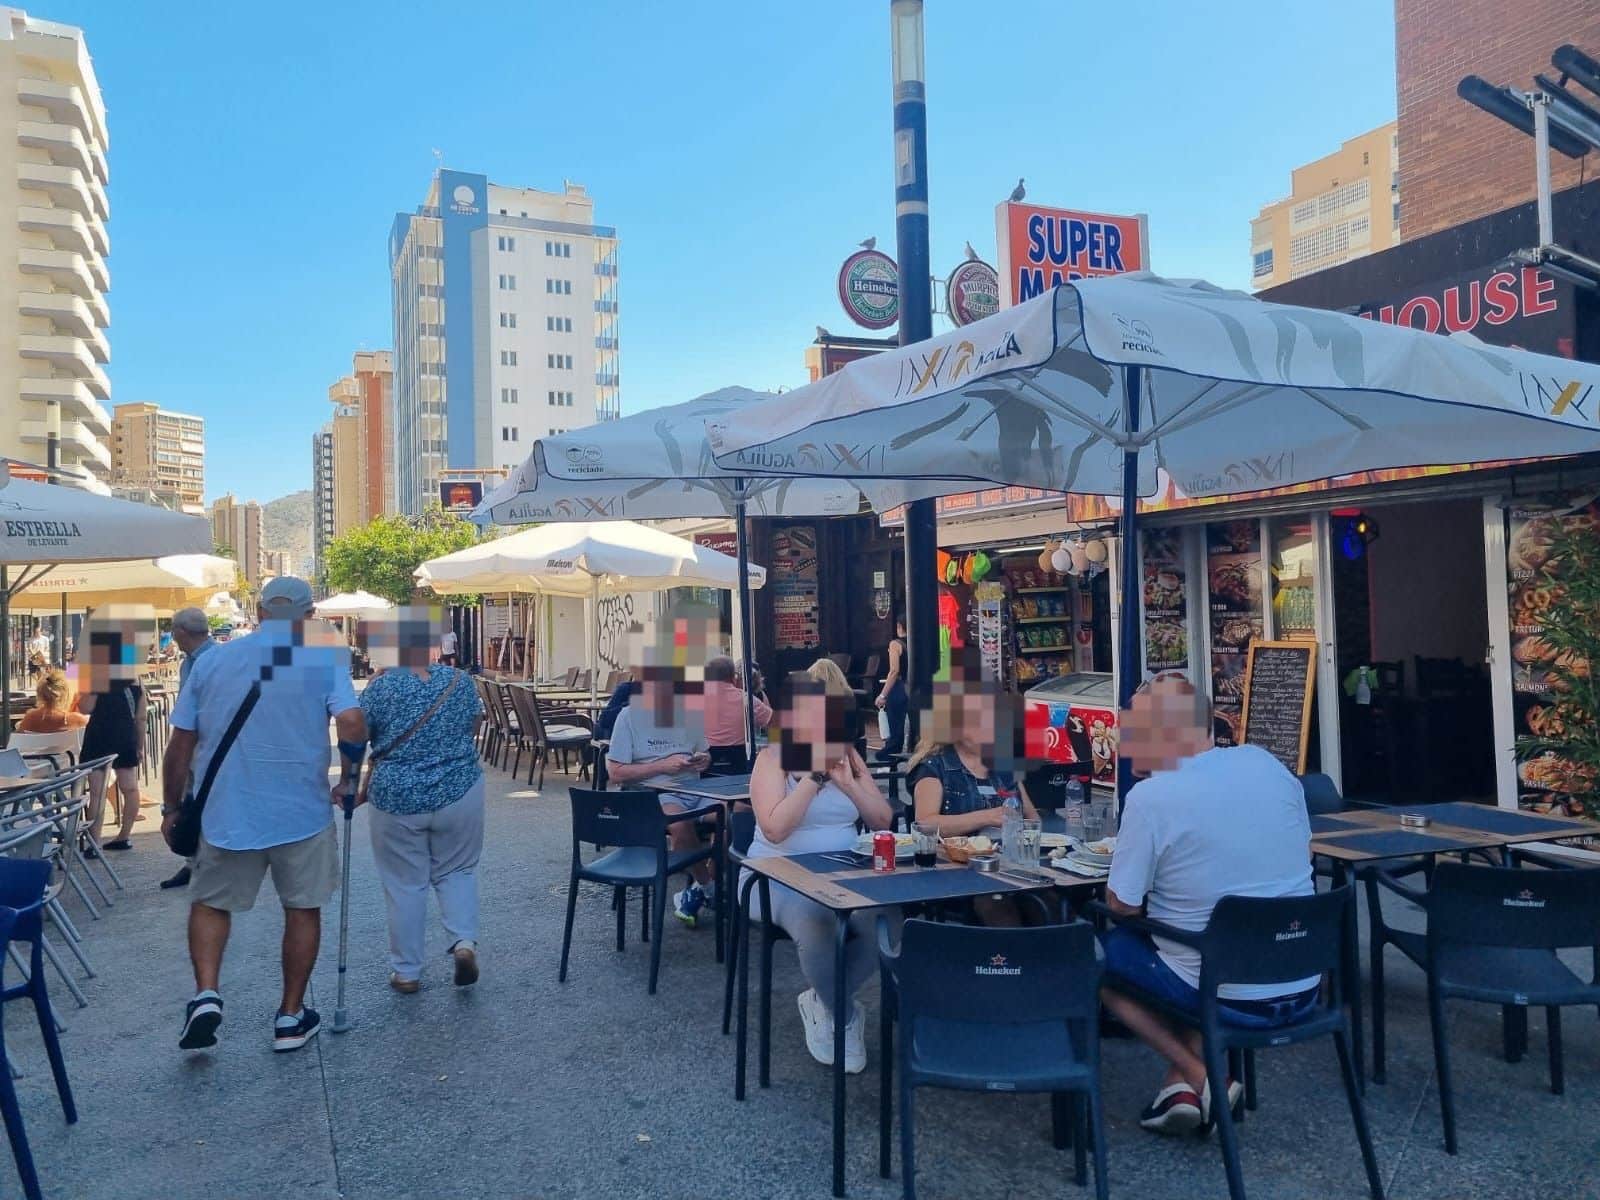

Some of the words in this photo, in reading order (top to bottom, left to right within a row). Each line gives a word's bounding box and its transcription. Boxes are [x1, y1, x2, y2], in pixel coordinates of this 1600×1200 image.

[1027, 213, 1126, 272] SUPER
[5, 520, 82, 537] ESTRELLA
[27, 538, 37, 546] DE
[39, 538, 69, 546] LEVANTE
[975, 965, 1022, 976] Heineken
